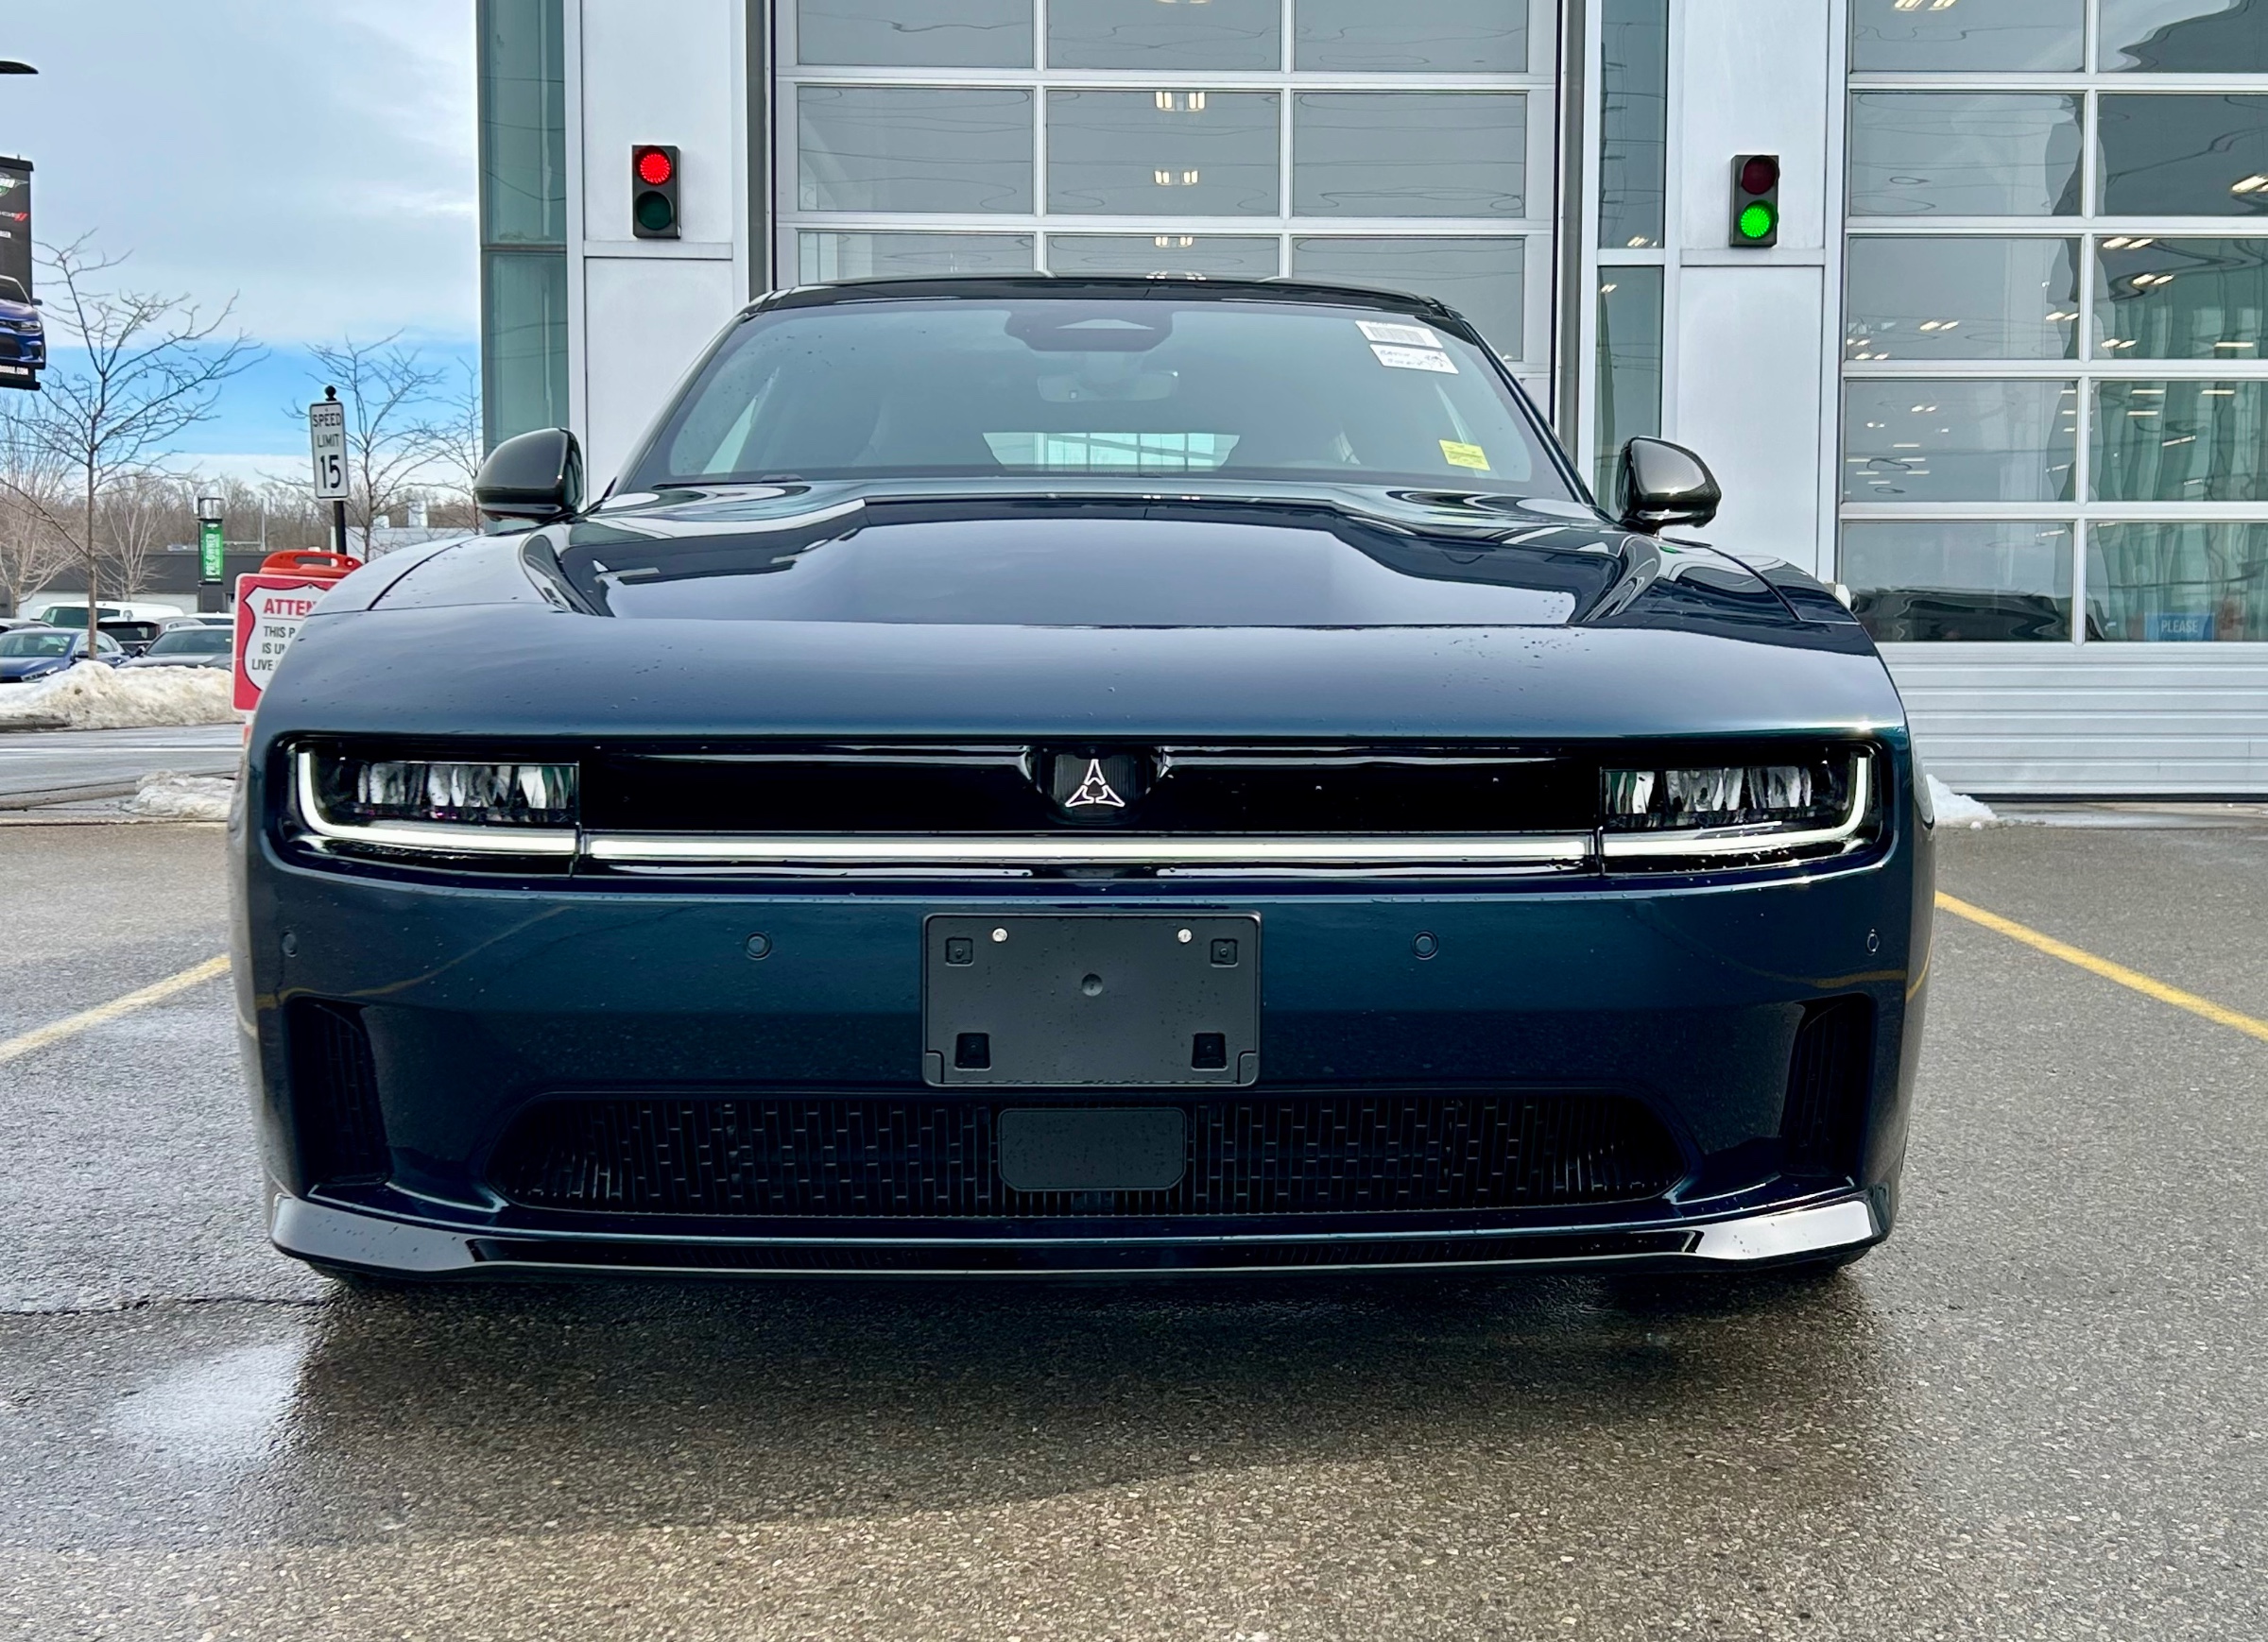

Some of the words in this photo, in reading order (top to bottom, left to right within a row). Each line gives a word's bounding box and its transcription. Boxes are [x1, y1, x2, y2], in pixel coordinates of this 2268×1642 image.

[312, 413, 342, 427] SPEED
[317, 434, 340, 448] LIMIT
[320, 454, 341, 489] 15
[206, 534, 215, 575] PRE-OWNED
[264, 598, 317, 616] ATTEN
[264, 625, 286, 639] THIS
[288, 627, 296, 639] P
[2160, 620, 2199, 633] PLEASE
[261, 642, 272, 655] IS
[274, 643, 286, 655] U
[251, 659, 274, 672] LIVE
